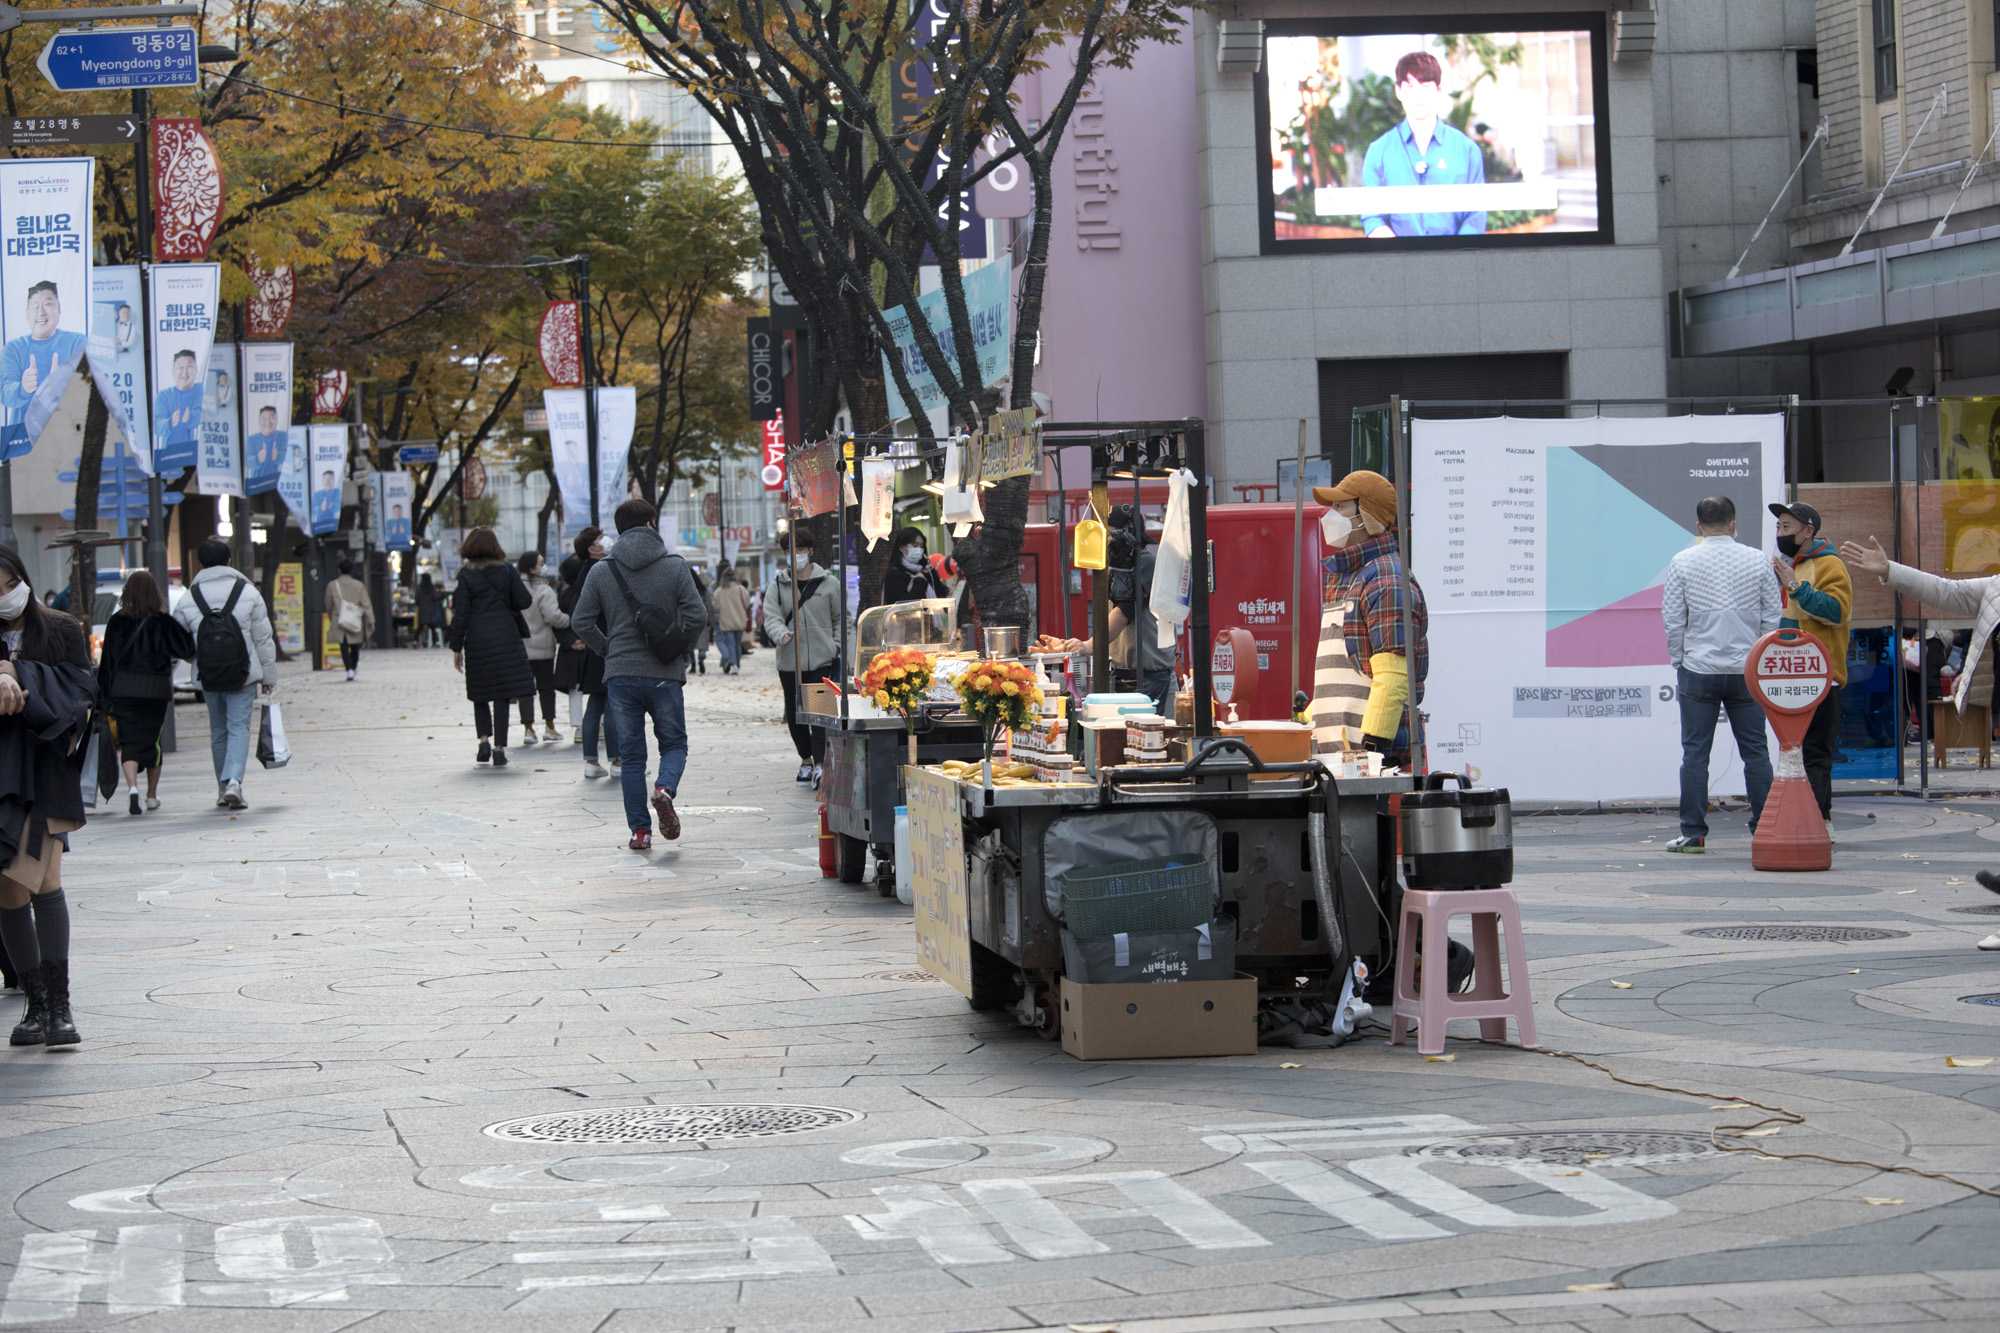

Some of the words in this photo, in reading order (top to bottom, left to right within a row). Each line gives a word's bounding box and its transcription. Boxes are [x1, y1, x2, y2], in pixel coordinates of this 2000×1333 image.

[56, 46, 68, 55] 62
[79, 45, 83, 54] 1
[132, 33, 191, 54] 명동8길
[81, 57, 161, 72] Myeongdong
[164, 55, 192, 70] 8-gil
[16, 213, 72, 235] 힘내요
[7, 234, 80, 256] 대한민국
[165, 303, 206, 317] 힘내요
[160, 318, 211, 332] 대한민국
[254, 372, 283, 382] 힘내요
[751, 334, 772, 405] CHICOR
[249, 381, 287, 393] 대한민국
[1238, 598, 1285, 615] 예술新세계
[1764, 656, 1821, 673] 주차금지
[1784, 685, 1819, 696] 국립극단
[1142, 960, 1189, 976] 새벽배송
